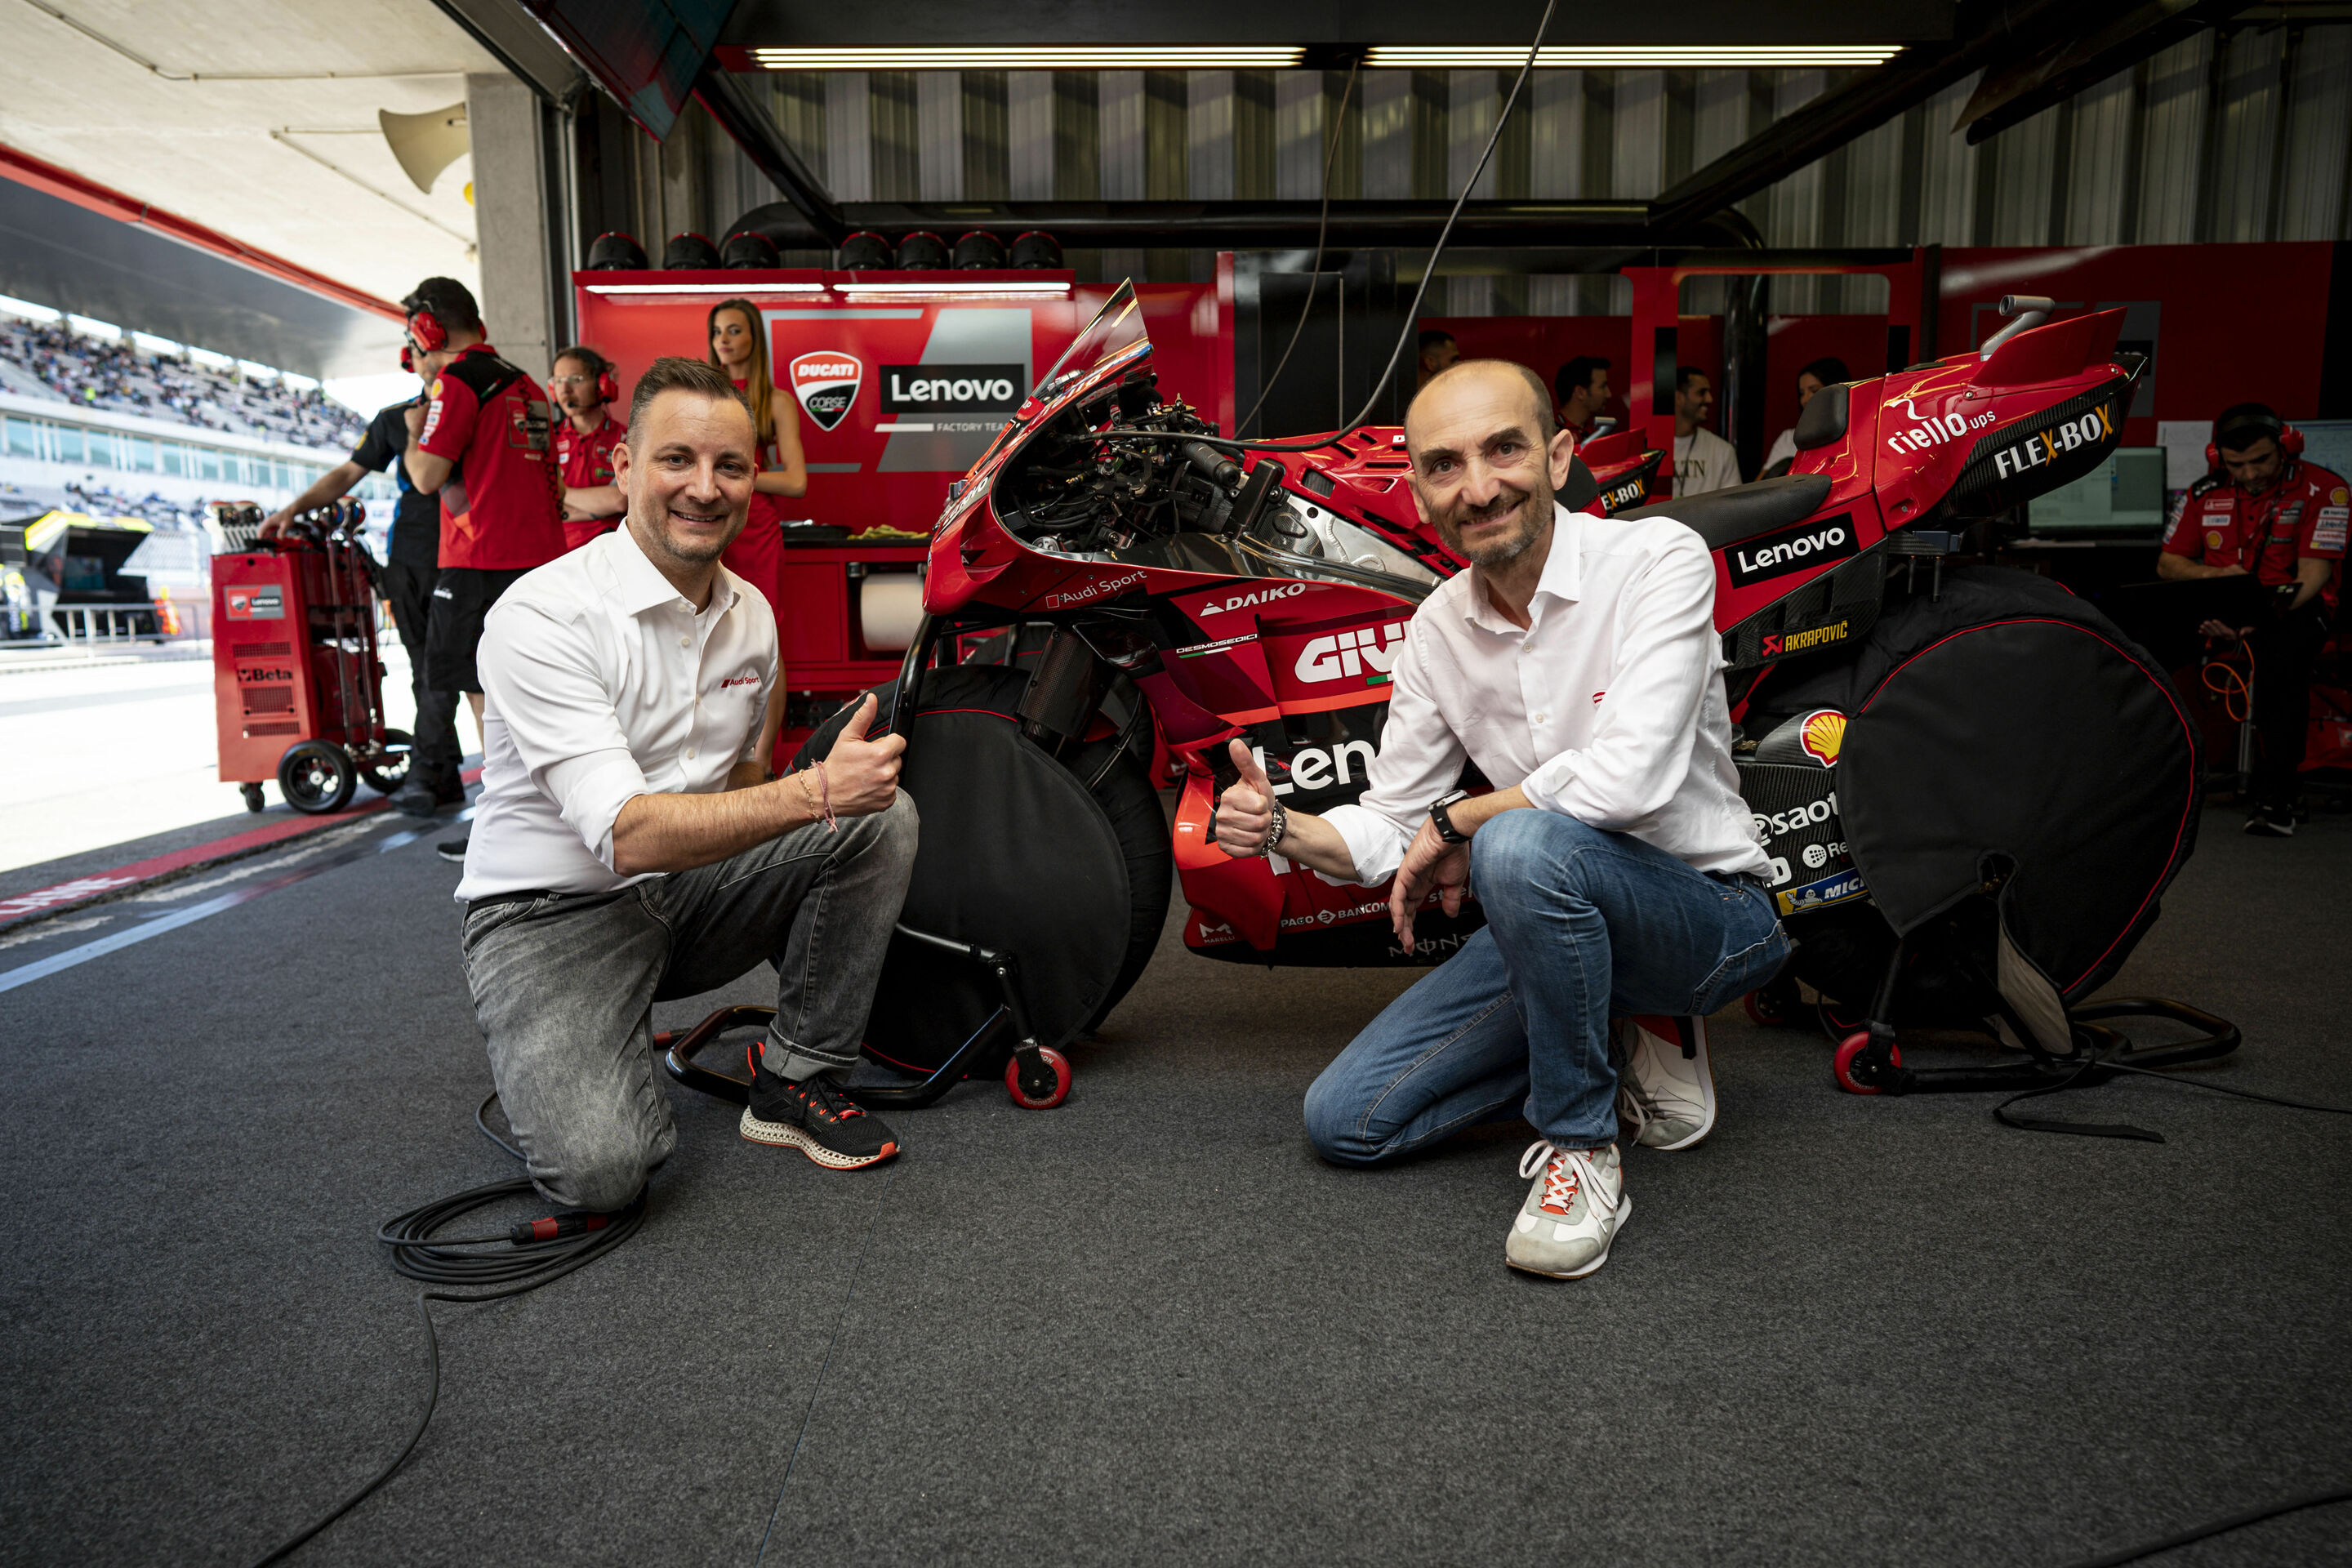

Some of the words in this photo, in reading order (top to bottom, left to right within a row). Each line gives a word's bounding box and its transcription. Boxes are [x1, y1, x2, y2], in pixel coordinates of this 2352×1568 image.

[797, 363, 855, 377] DUCATI
[808, 396, 847, 408] CORSE
[891, 374, 1014, 402] Lenovo
[937, 422, 982, 432] FACTORY
[984, 422, 1006, 432] TEA
[1887, 412, 1968, 455] riello
[1969, 410, 1997, 430] ups
[1993, 403, 2114, 480] FLEX-BOX
[1601, 478, 1646, 510] EX-BOX
[1737, 527, 1846, 573] Lenovo
[1062, 581, 1098, 604] Audi
[1098, 570, 1148, 593] Sport
[1225, 581, 1307, 612] DAIKO
[1176, 632, 1258, 653] DESMOSEDICI
[1294, 619, 1411, 684] GIV
[1784, 620, 1848, 653] AKRAPOVIČ
[252, 668, 292, 681] Beta
[729, 678, 745, 686] Audi
[744, 676, 760, 685] Sport
[1252, 740, 1377, 796] Len
[1751, 791, 1839, 847] esaot
[1280, 915, 1315, 928] PAGO
[1337, 901, 1390, 920] BANCOM
[1203, 935, 1236, 944] MARELLI
